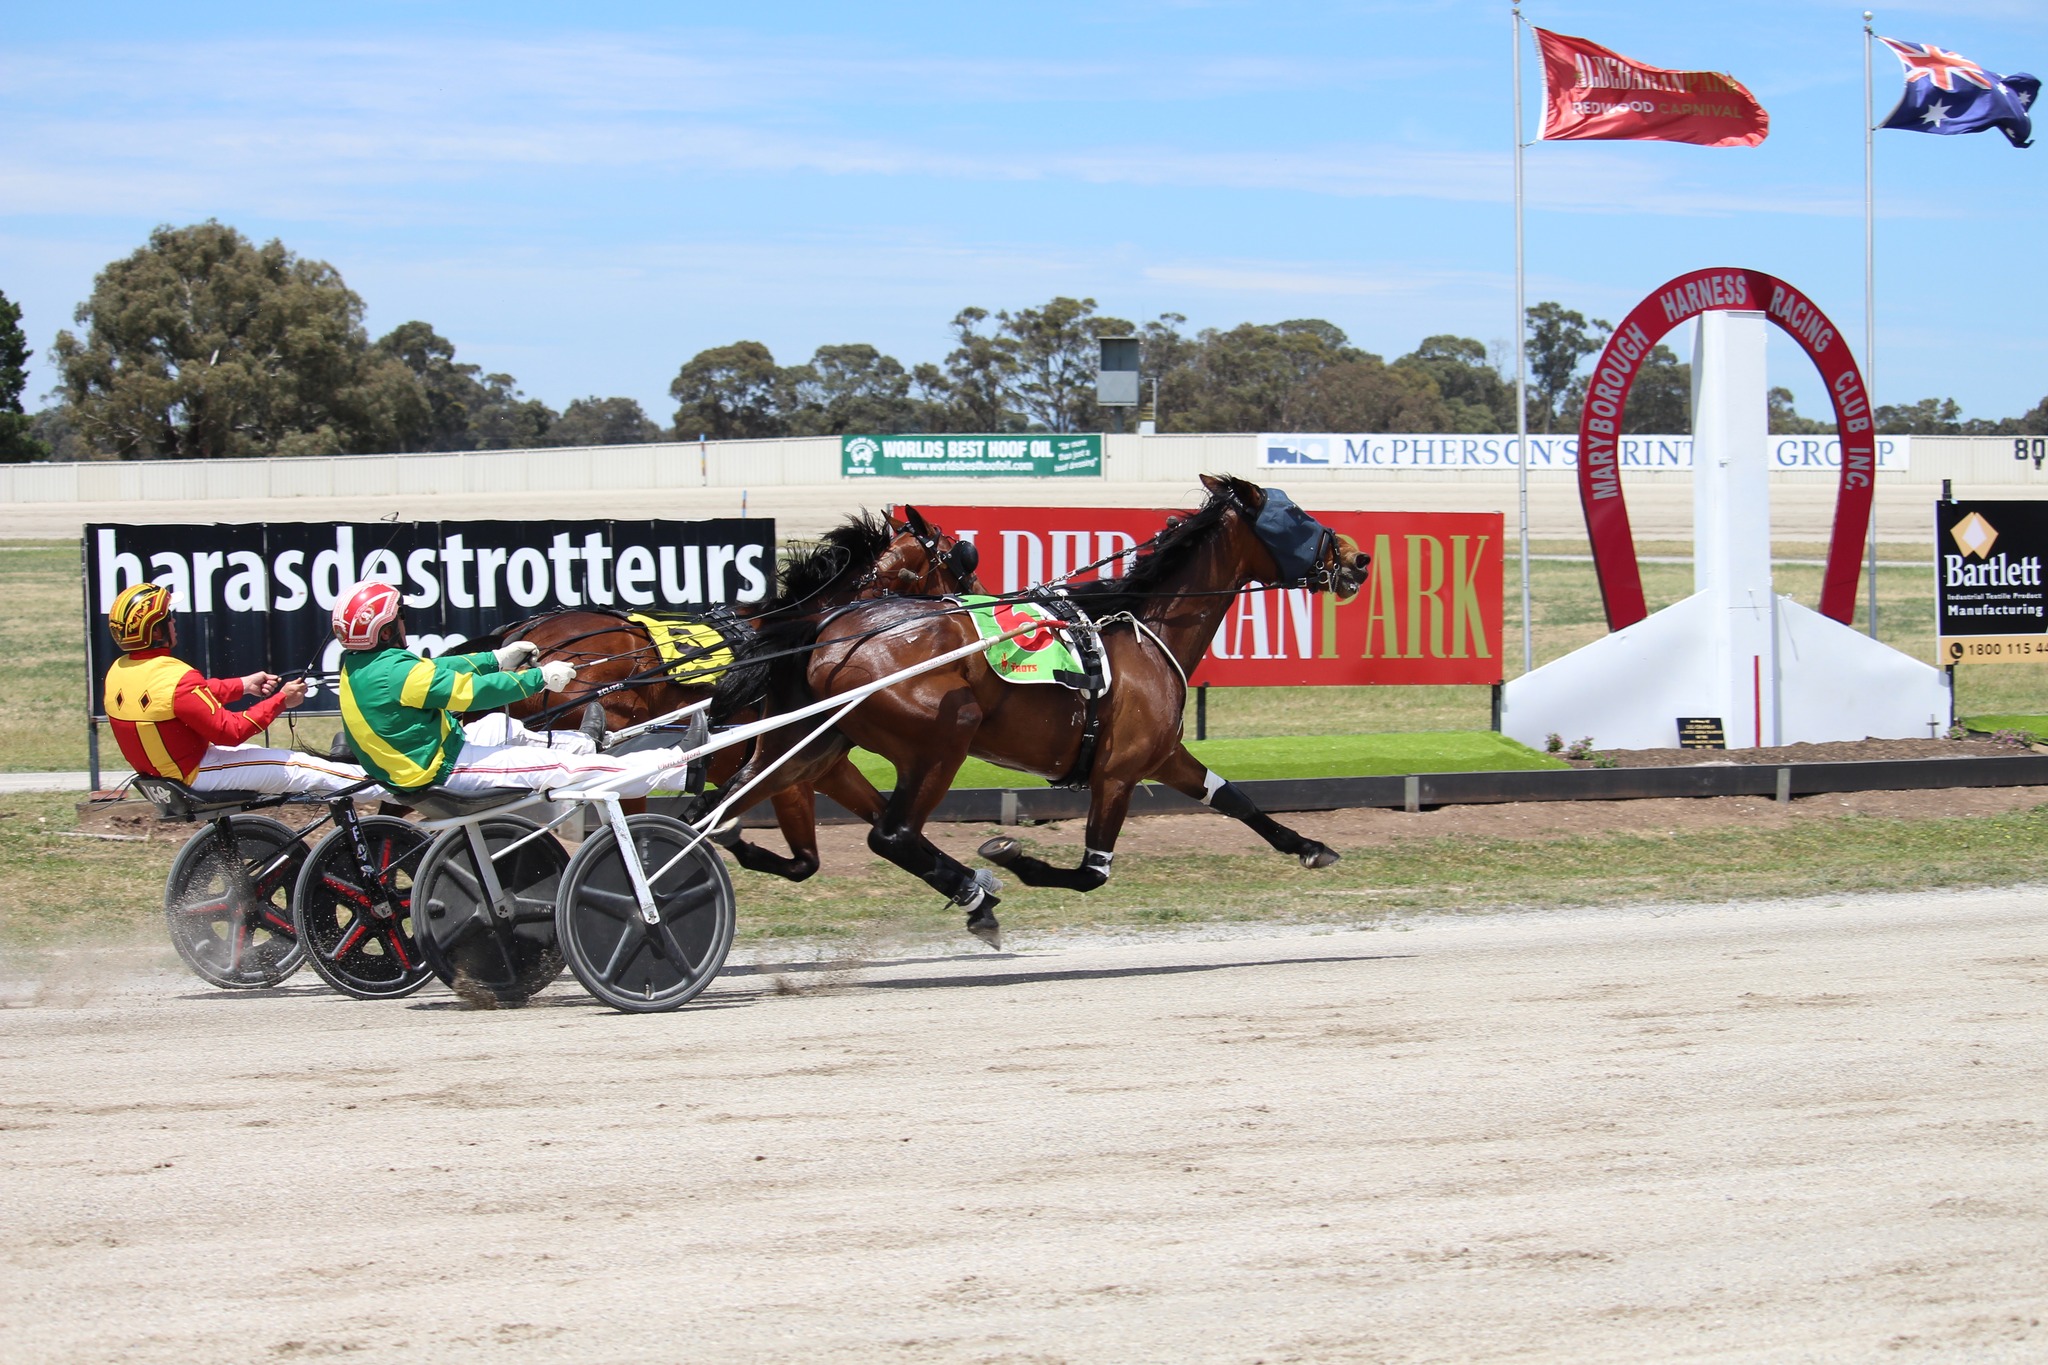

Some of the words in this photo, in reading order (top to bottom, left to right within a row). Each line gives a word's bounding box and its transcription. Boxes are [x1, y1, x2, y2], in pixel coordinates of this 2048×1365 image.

[1572, 101, 1655, 115] REDWOOD
[1658, 103, 1743, 118] CARNIVAL
[1659, 274, 1747, 323] HARNESS
[1769, 285, 1833, 353] RACING
[1588, 322, 1650, 500] MARYBOROUGH
[1834, 370, 1869, 433] CLUB
[882, 440, 945, 458] WORLDS
[947, 440, 984, 458] BEST
[987, 440, 1027, 458] HOOF
[1029, 440, 1055, 458] OIL
[1776, 440, 1895, 467] GROP
[1844, 447, 1871, 490] INC.
[97, 525, 767, 615] harasdestrotteurs
[1944, 552, 2042, 587] Bartlett
[1946, 593, 1985, 601] Industrial
[1985, 592, 2011, 600] Textile
[2013, 592, 2042, 600] Product
[1947, 603, 2043, 617] Manufacturing
[1968, 643, 2001, 656] 1800
[2007, 642, 2031, 655] 115
